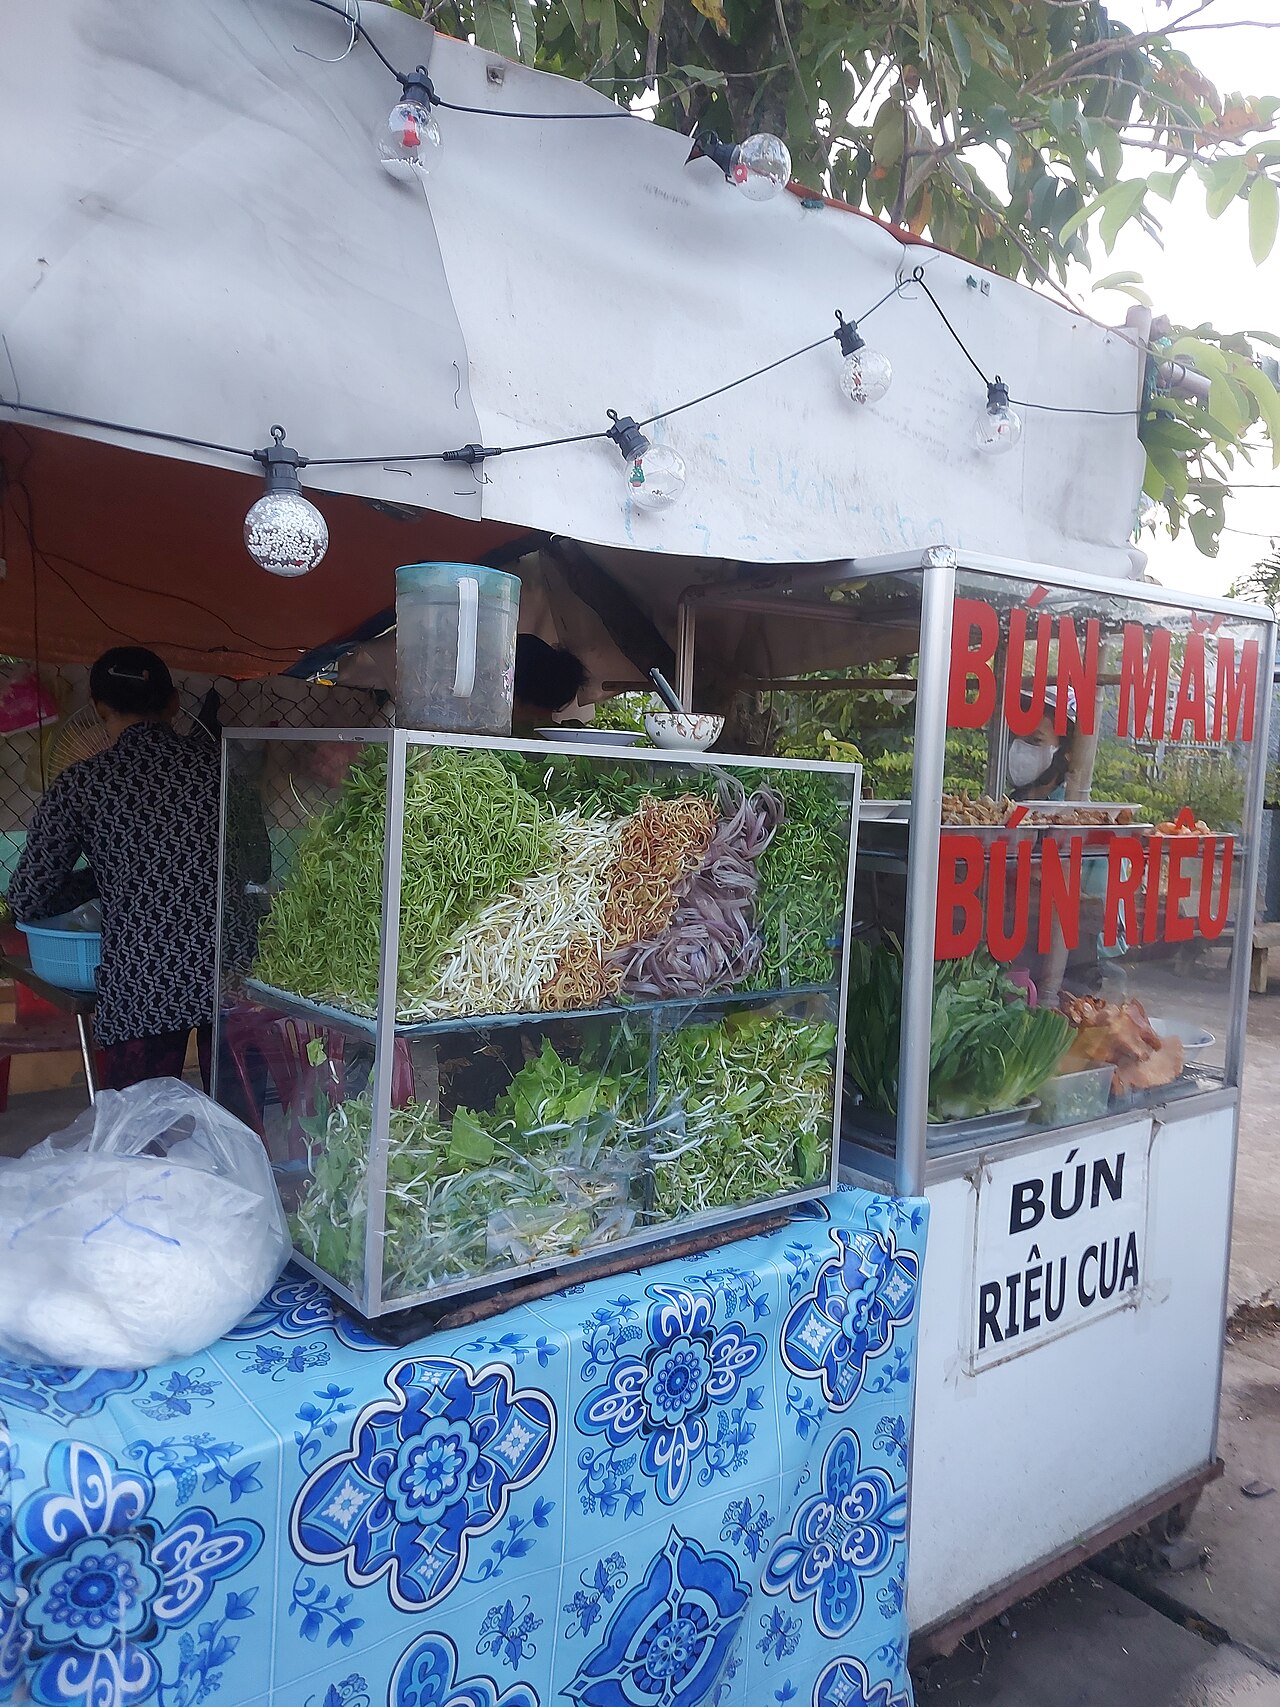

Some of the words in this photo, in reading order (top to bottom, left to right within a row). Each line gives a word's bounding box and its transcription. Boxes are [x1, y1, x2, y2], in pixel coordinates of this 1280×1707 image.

[947, 584, 1098, 736] BÚN
[935, 806, 1082, 962] BÚN
[1103, 806, 1233, 947] RIÊU
[1009, 1148, 1125, 1235] BÚN
[978, 1244, 1067, 1350] RIÊU
[1077, 1231, 1139, 1308] CUA
